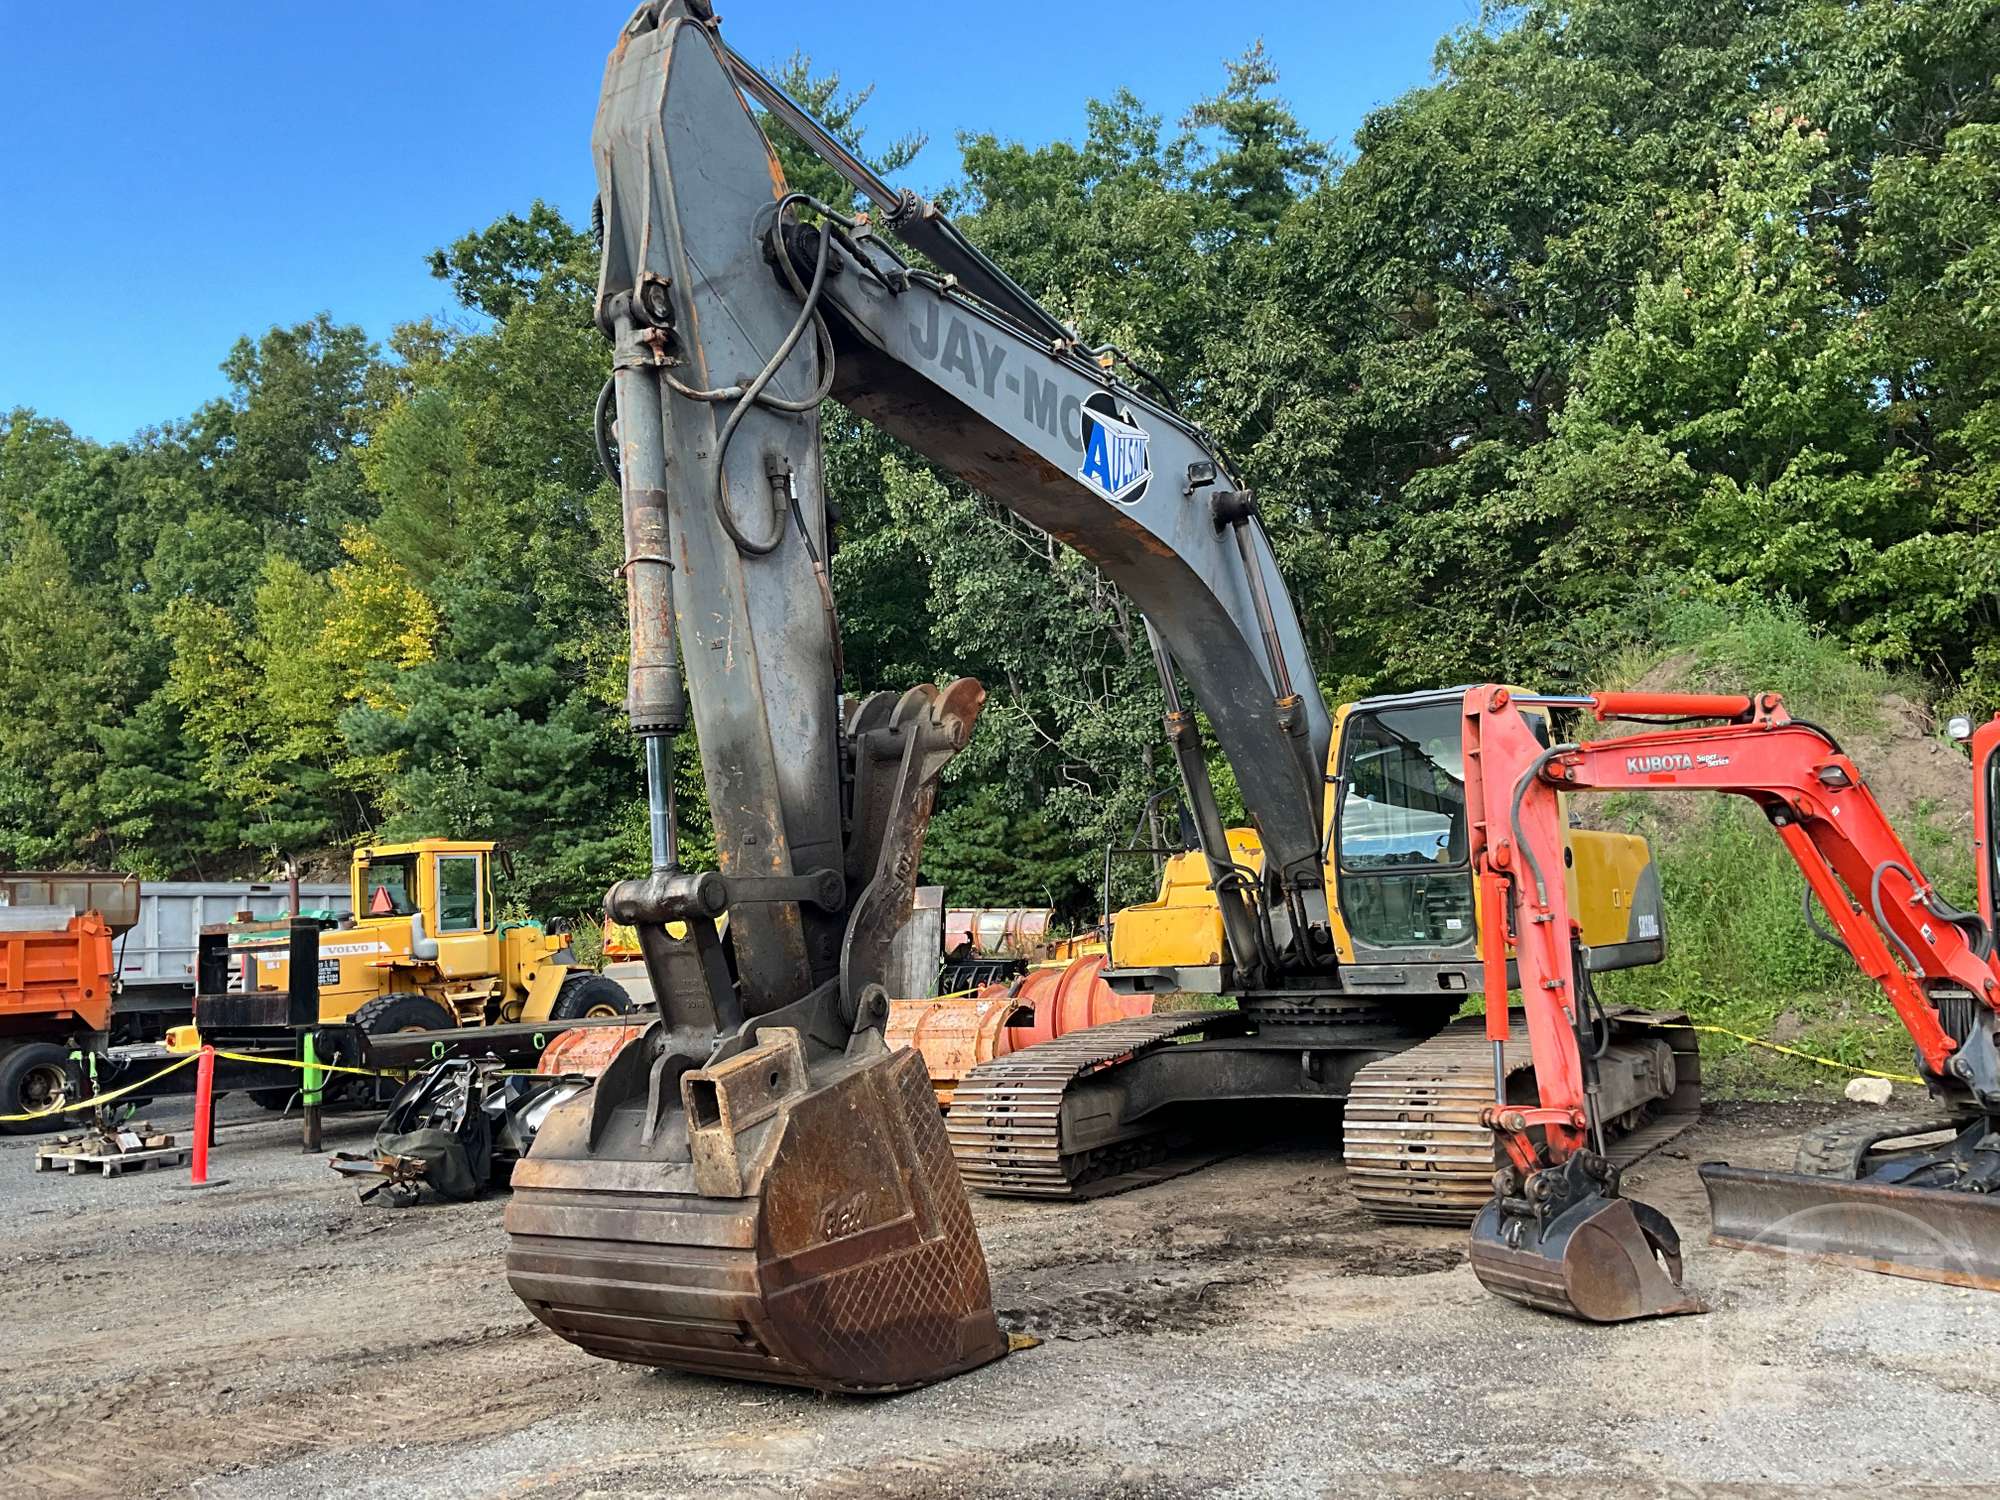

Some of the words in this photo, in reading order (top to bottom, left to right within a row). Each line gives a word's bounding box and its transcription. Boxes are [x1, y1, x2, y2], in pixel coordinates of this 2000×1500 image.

[1626, 753, 1693, 774] KUBOTA
[1696, 753, 1718, 764] Super
[328, 944, 369, 955] VOLVO
